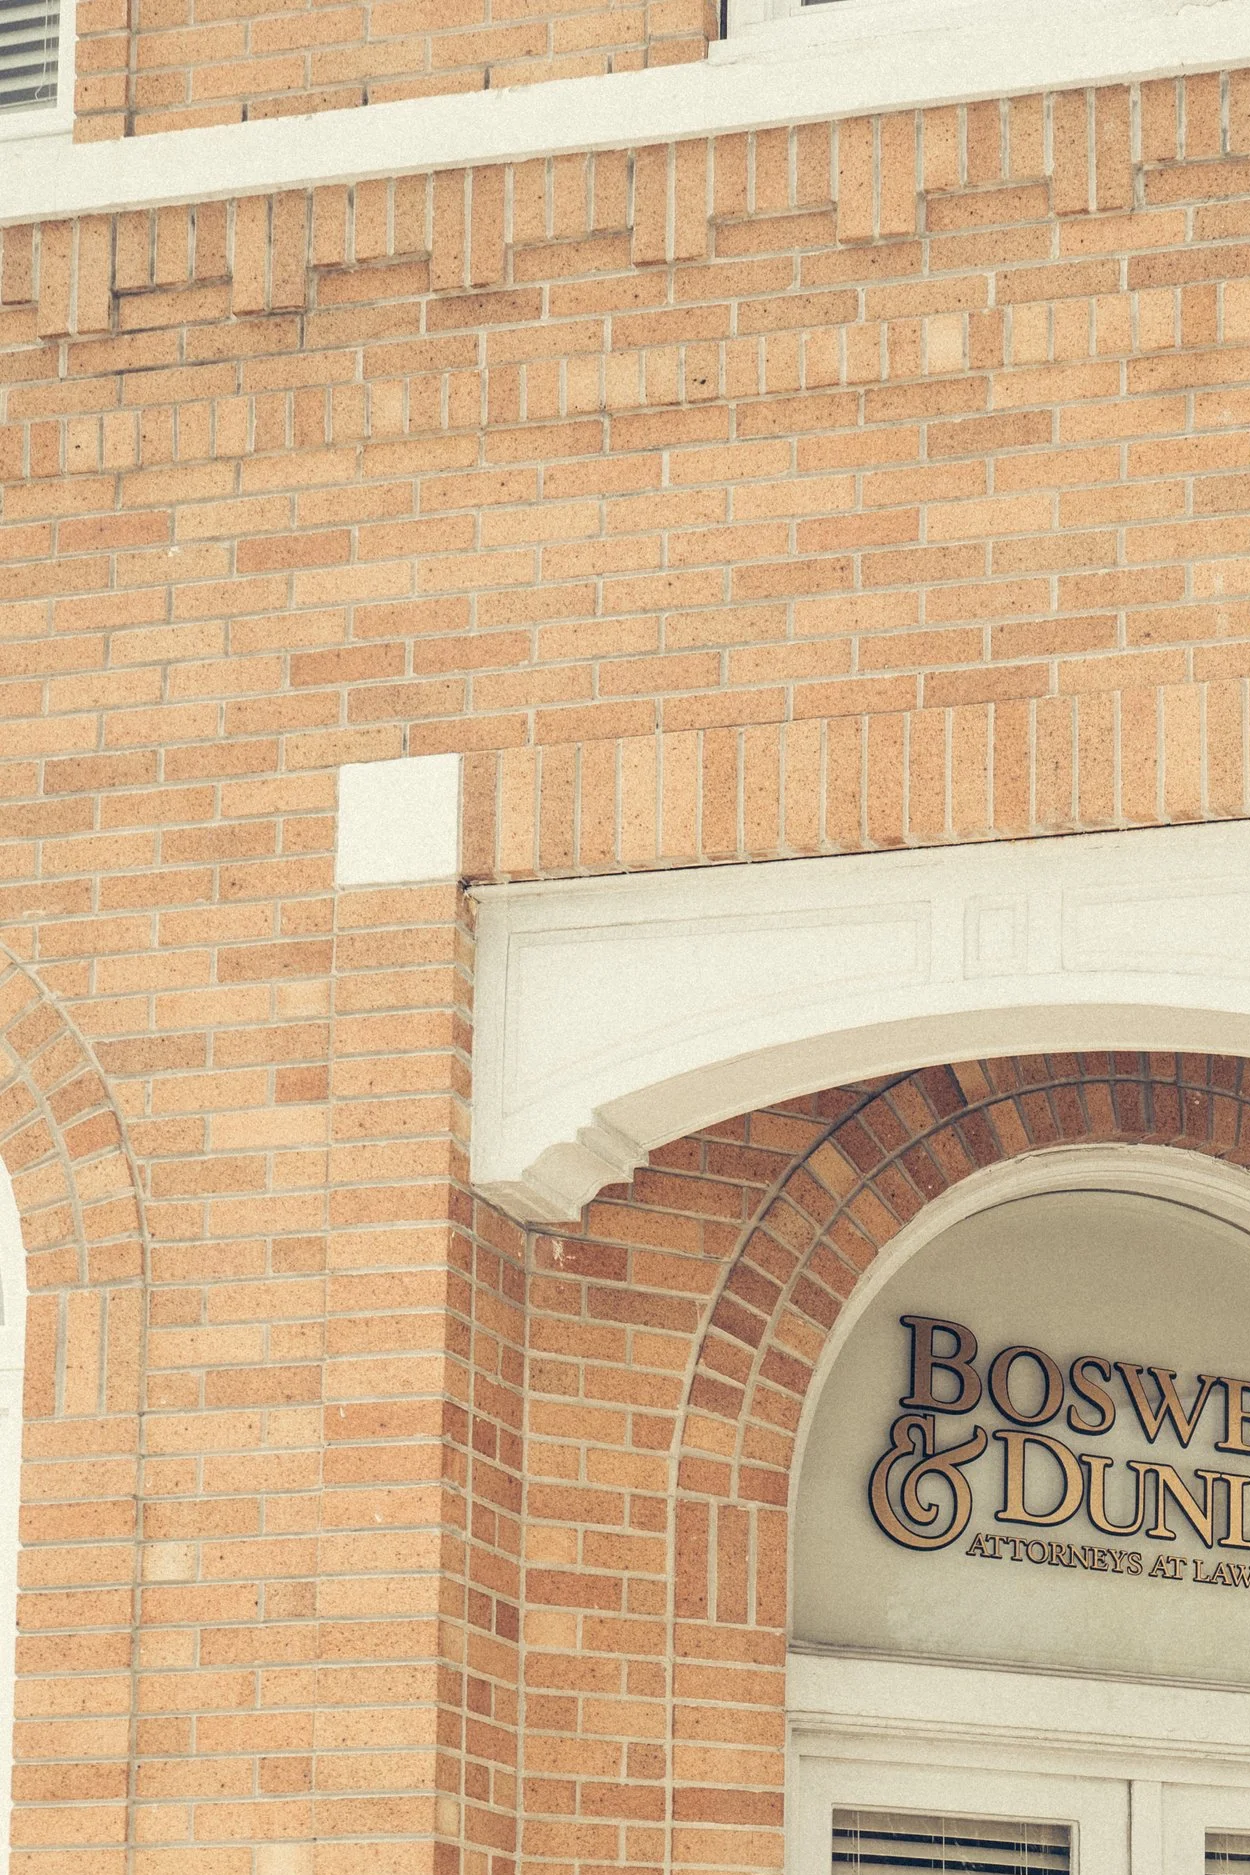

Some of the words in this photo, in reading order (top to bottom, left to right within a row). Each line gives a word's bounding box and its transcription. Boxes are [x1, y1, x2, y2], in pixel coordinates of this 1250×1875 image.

[868, 1413, 988, 1550] &
[966, 1532, 1143, 1577] ATTORNEYS
[1149, 1555, 1187, 1581] AT
